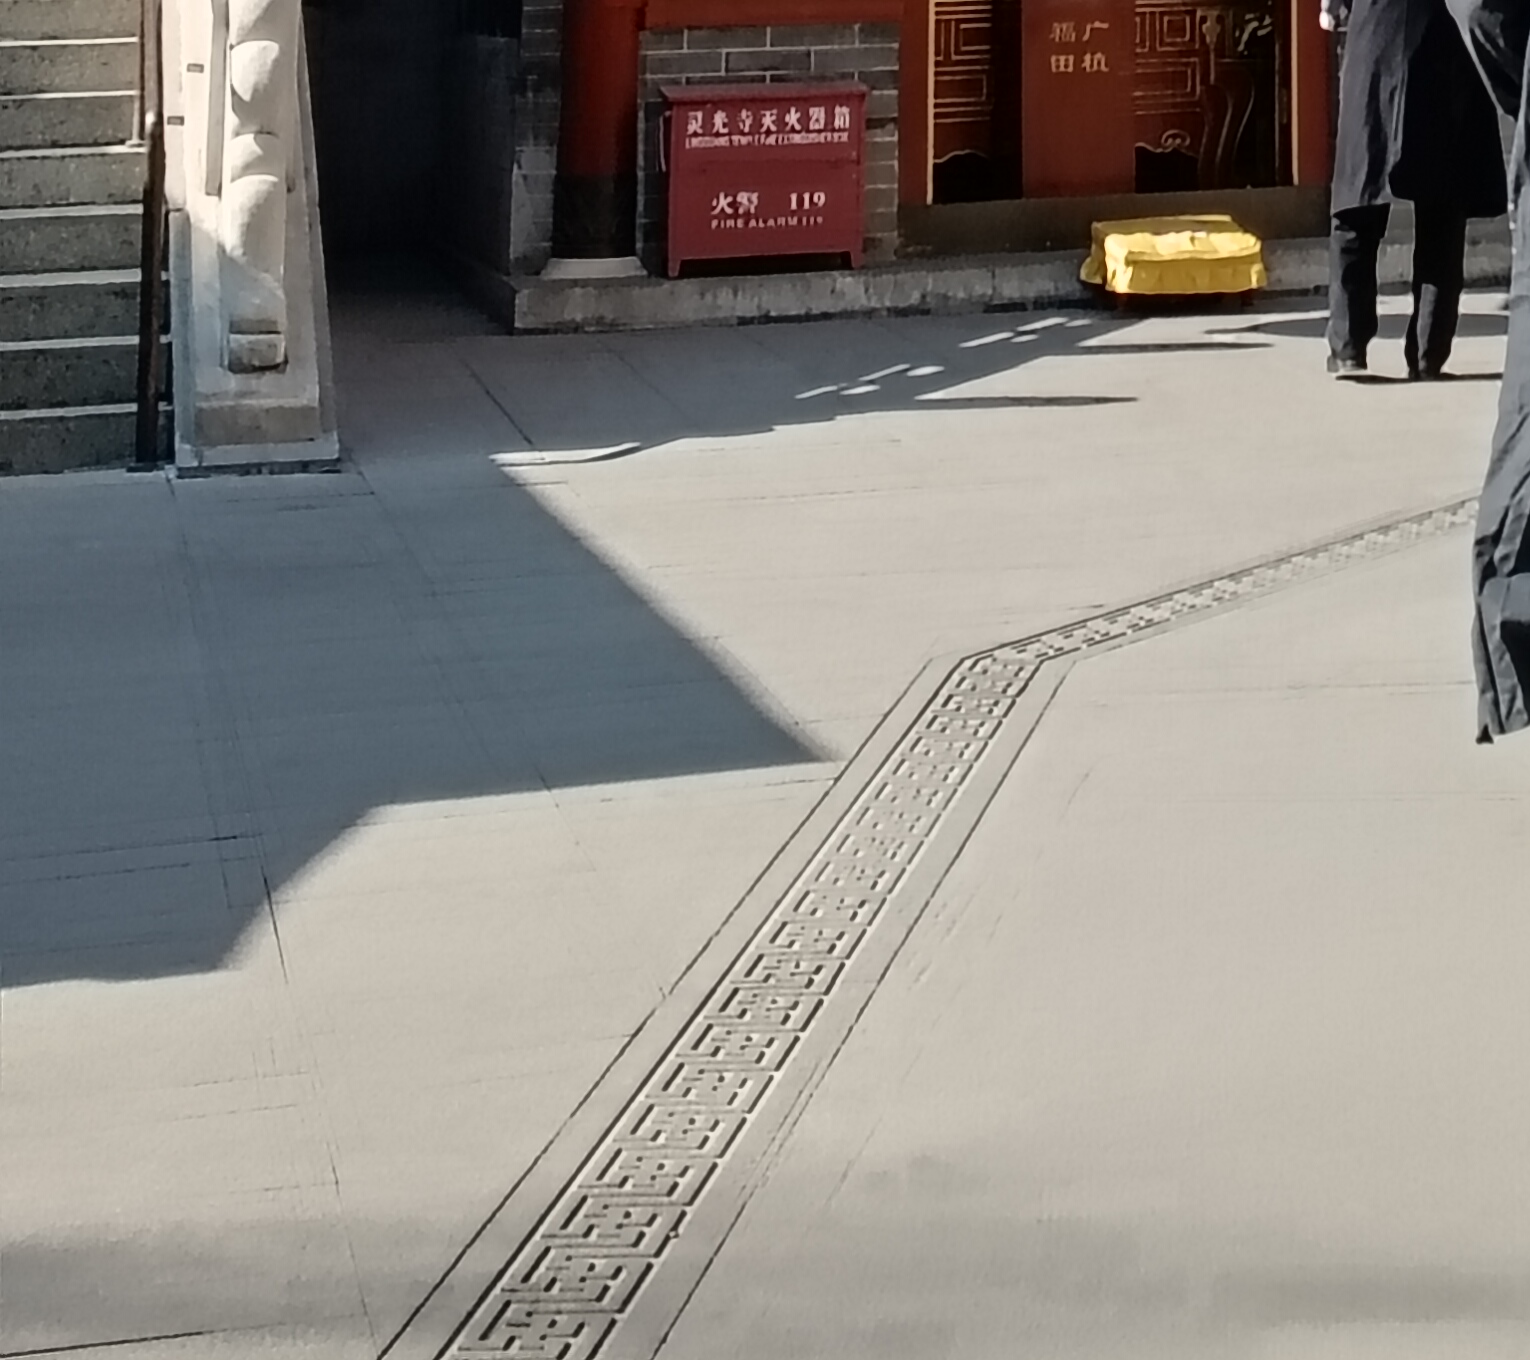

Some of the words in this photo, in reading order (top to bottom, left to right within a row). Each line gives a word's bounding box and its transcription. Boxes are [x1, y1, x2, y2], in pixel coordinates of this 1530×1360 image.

[687, 105, 850, 135] 灵光寺灭火器箱
[711, 191, 759, 215] 火警
[789, 191, 826, 210] 119
[711, 218, 745, 230] FIRE
[748, 216, 798, 229] ALARM
[802, 216, 823, 227] 119
